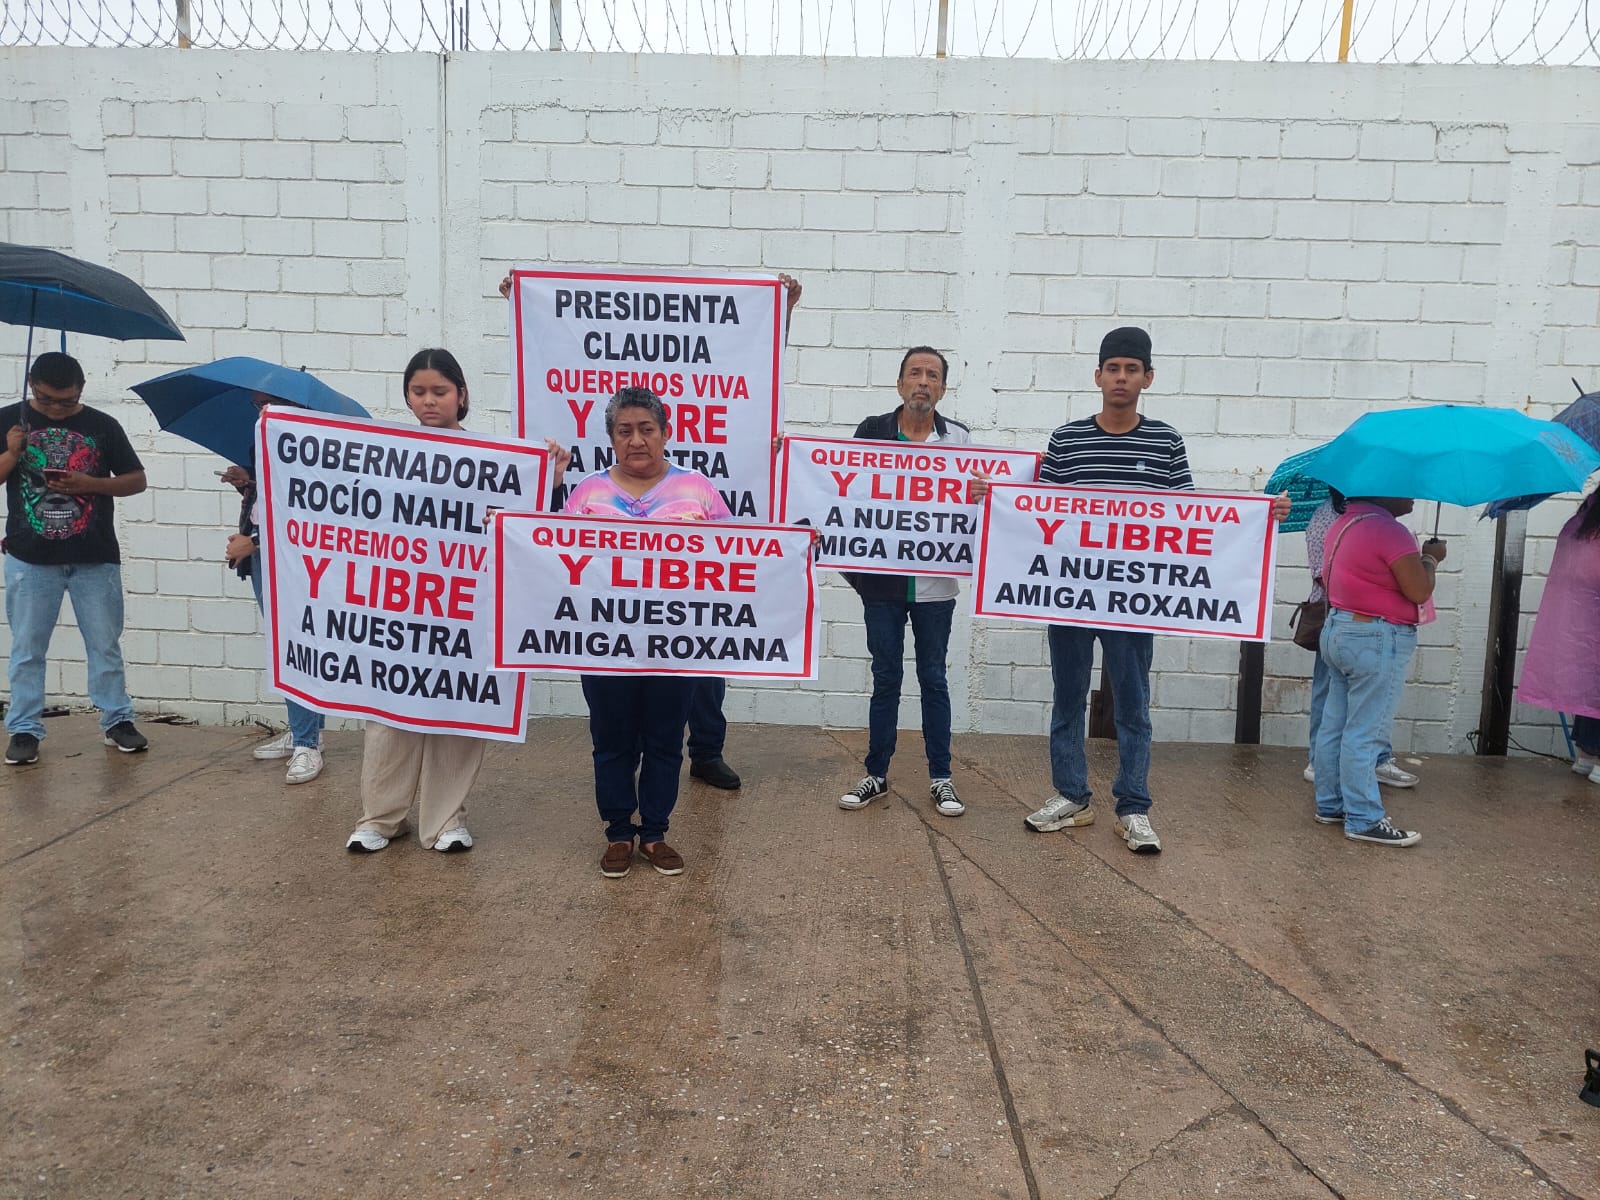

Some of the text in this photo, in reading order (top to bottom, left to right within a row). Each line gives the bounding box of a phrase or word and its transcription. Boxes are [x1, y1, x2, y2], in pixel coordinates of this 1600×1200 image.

[555, 289, 739, 325] PRESIDENTA
[583, 331, 712, 364] CLAUDIA
[546, 368, 749, 399] QUEREMOS VIVA
[567, 399, 595, 438] Y
[277, 432, 522, 496] GOBERNADORA
[566, 446, 729, 478] A NTRA
[811, 448, 1012, 476] QUEREMOS VIVA
[287, 477, 382, 520] ROCÍO
[831, 471, 858, 497] Y
[824, 506, 844, 527] A
[1014, 494, 1241, 524] QUEREMOS VIVA
[286, 518, 487, 573] QUEREMOS VIV
[532, 526, 784, 557] QUEREMOS VIVA
[810, 532, 973, 564] MIGA ROXA
[1036, 518, 1214, 556] Y LIBRE
[301, 554, 477, 621] Y LIBRE
[558, 554, 757, 592] Y LIBRE
[1028, 554, 1211, 589] A NUESTRA
[554, 596, 757, 628] A NUESTRA
[995, 582, 1242, 623] AMIGA ROXANA
[301, 605, 473, 660] A NUESTRA
[517, 629, 789, 662] AMIGA ROXANA
[286, 640, 501, 705] AMIGA ROXANA
